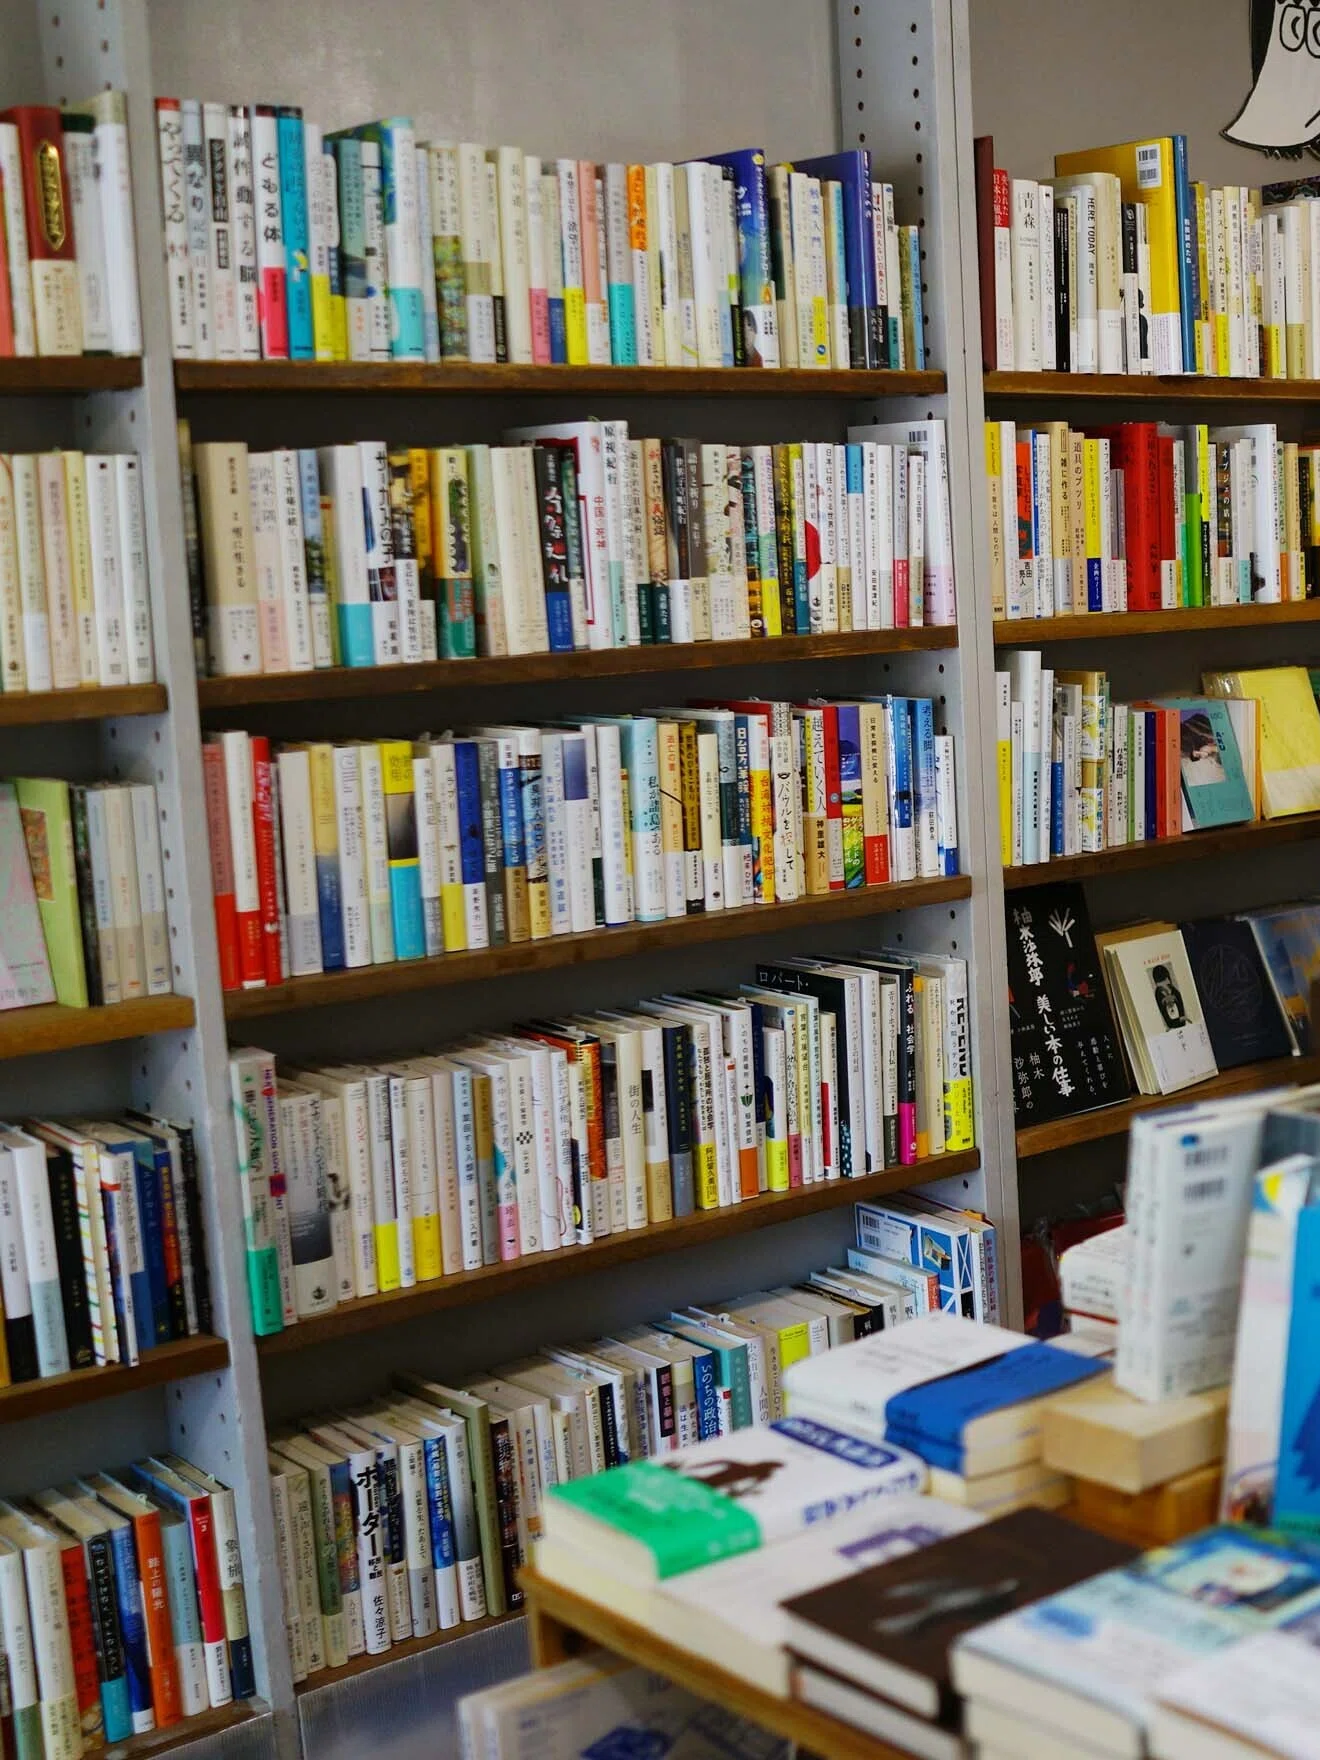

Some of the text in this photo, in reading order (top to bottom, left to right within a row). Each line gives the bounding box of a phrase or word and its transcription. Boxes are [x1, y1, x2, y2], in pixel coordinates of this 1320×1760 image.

[261, 153, 282, 245] どもる体
[1023, 192, 1036, 230] 青森
[1087, 197, 1097, 256] HERE TODAY
[824, 448, 836, 560] 日本に住んでる世界のひと
[1060, 457, 1069, 502] 雑に作る
[869, 717, 881, 785] 日常を探検に変える
[921, 703, 933, 754] 考える脚
[812, 716, 827, 812] 越えていく人
[778, 781, 795, 871] バウルを探して
[1013, 907, 1044, 987] 柚木沙弥郎
[758, 971, 809, 993] ロバート・
[799, 1012, 809, 1072] 言葉の展望台
[887, 989, 898, 1066] エリック・ホッファー自伝
[904, 982, 915, 1056] ふれる 社会学
[1036, 993, 1077, 1097] 美しい本の仕事
[702, 1047, 715, 1130] 孤独と居場所の社会学
[1014, 1056, 1035, 1110] 沙弥郎の
[1028, 1052, 1046, 1081] 柚木
[628, 1083, 642, 1136] 街の人生
[660, 1372, 675, 1430] 読書と暴動
[373, 1595, 386, 1641] 佐々涼子
